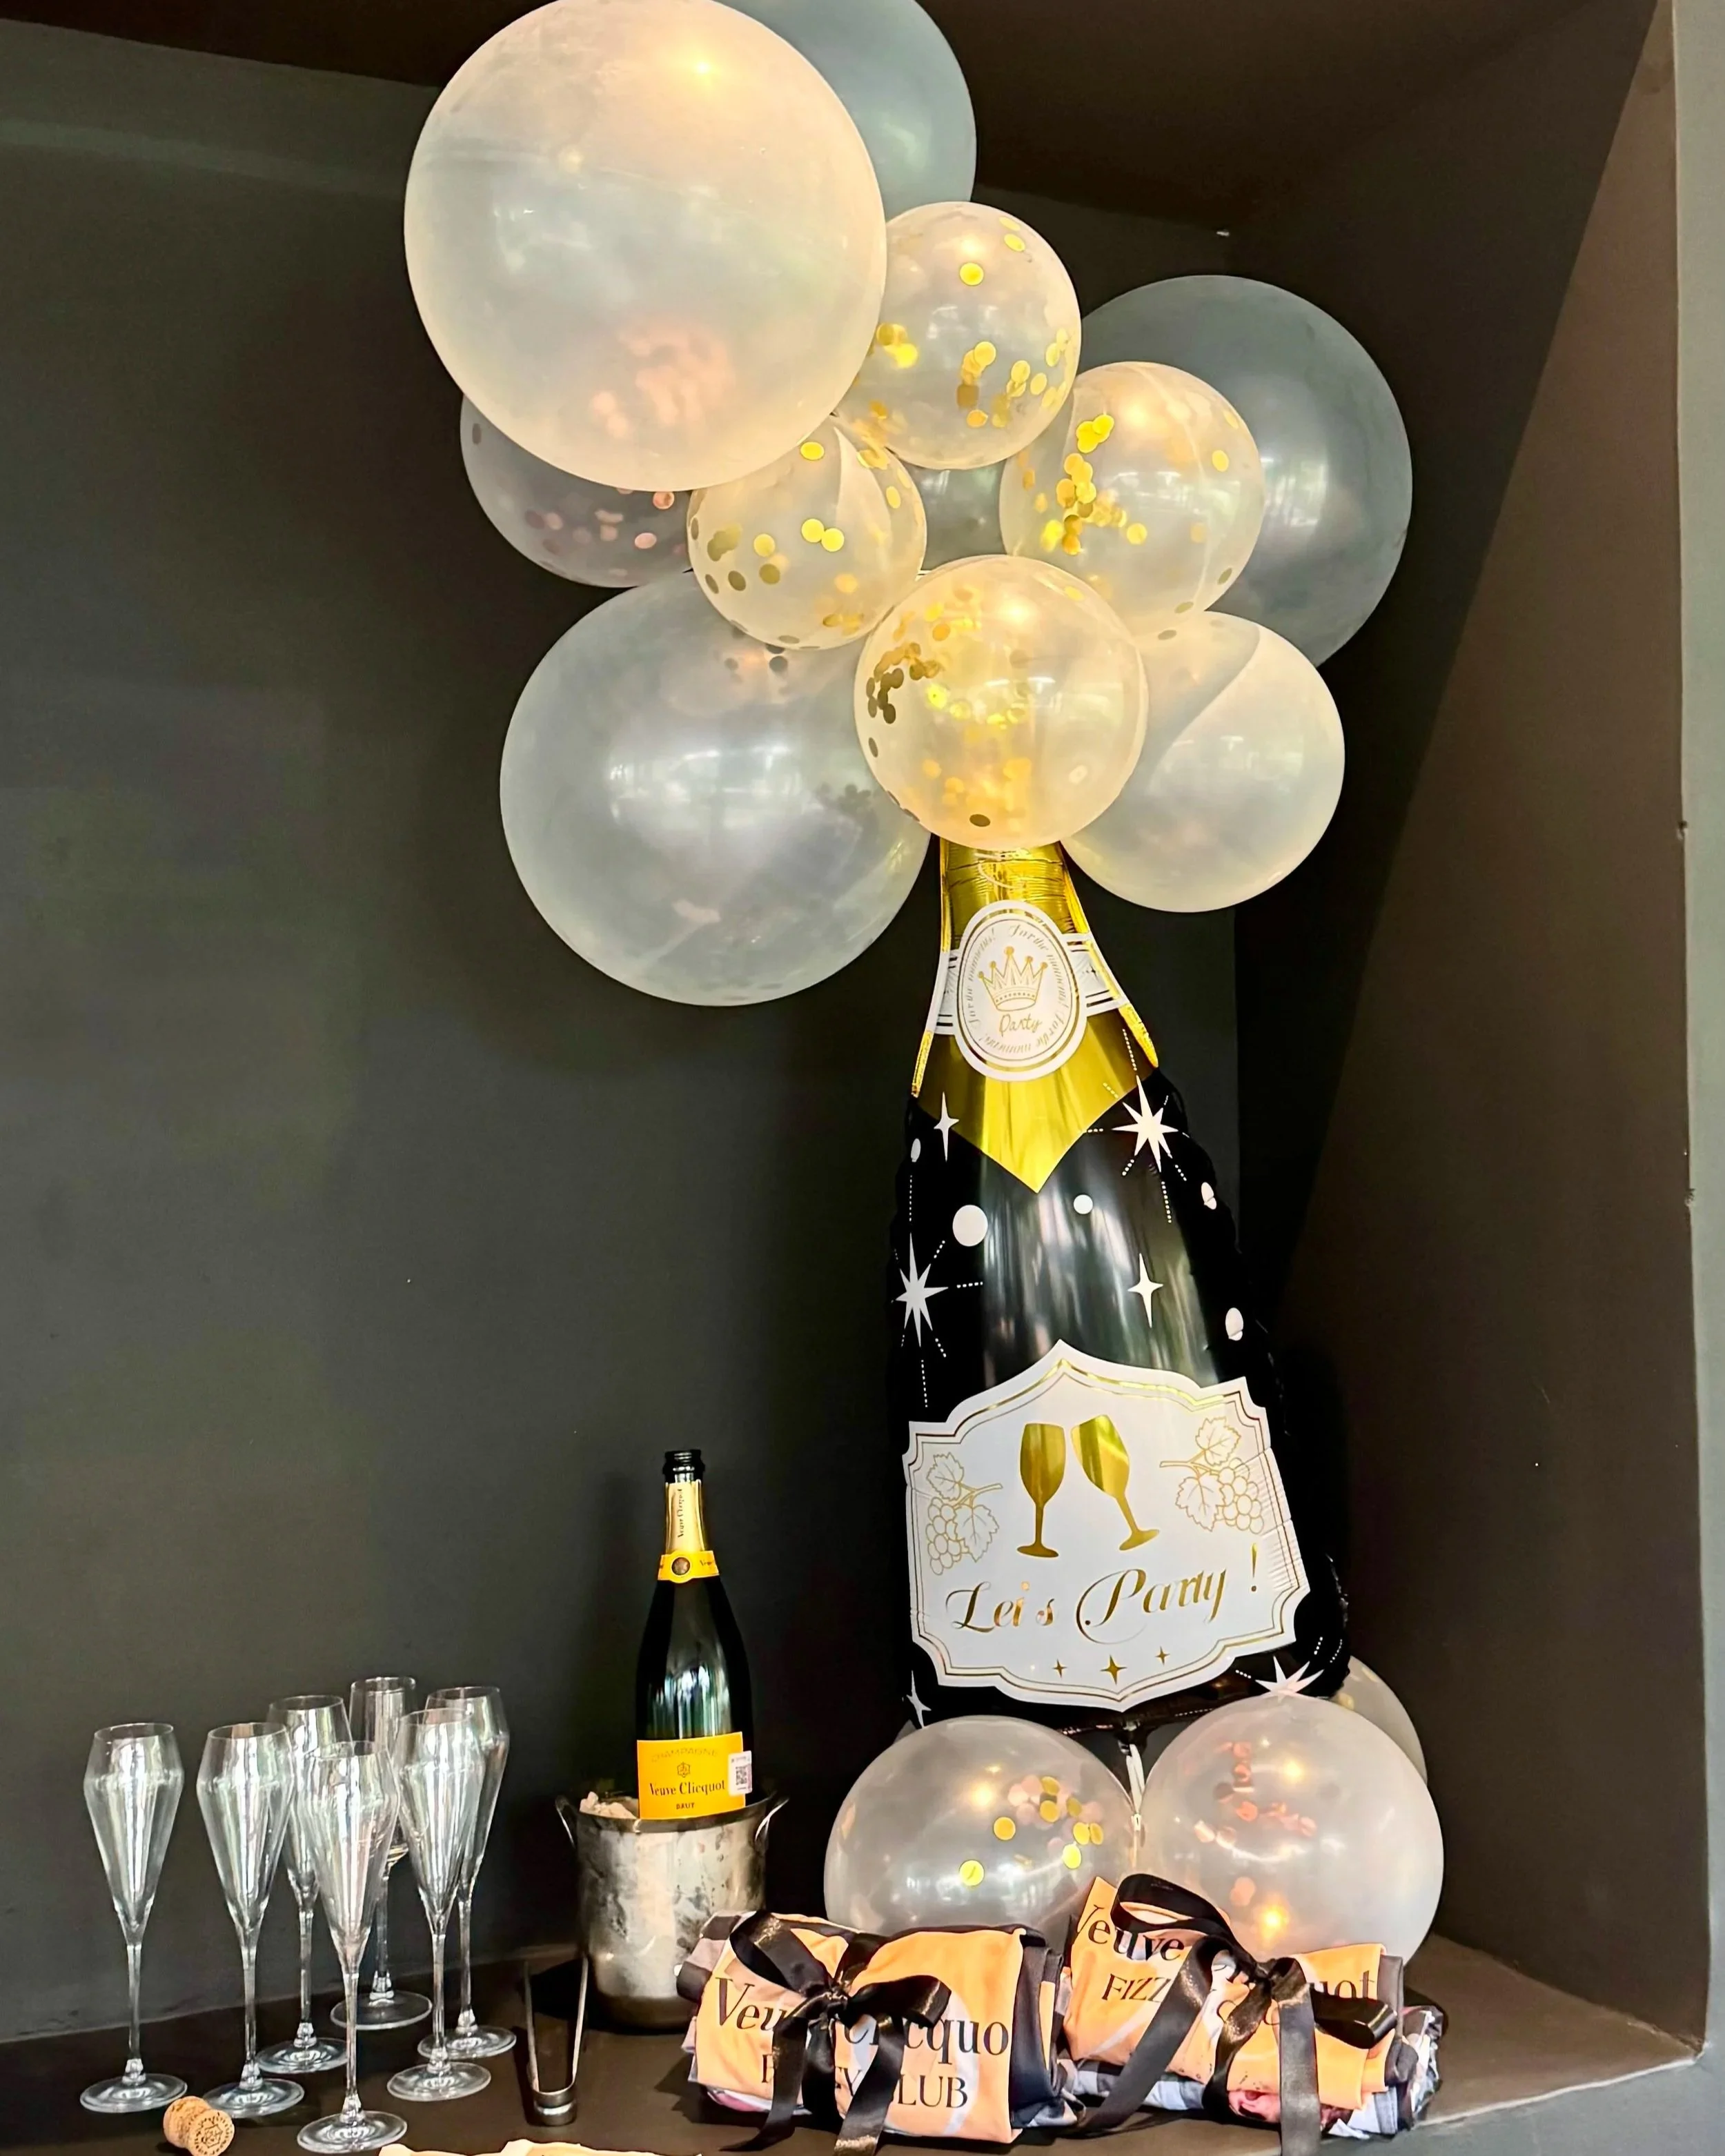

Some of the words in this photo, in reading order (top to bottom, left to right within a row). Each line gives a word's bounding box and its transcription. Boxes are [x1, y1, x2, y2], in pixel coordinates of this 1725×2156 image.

[998, 1013, 1043, 1038] Party
[1076, 1567, 1228, 1645] Party
[649, 1782, 676, 1796] Veuve
[678, 1779, 725, 1796] Clicquot
[714, 1977, 789, 2031] Veu
[1101, 1973, 1172, 2003] FIZZ
[897, 2073, 969, 2108] LUB
